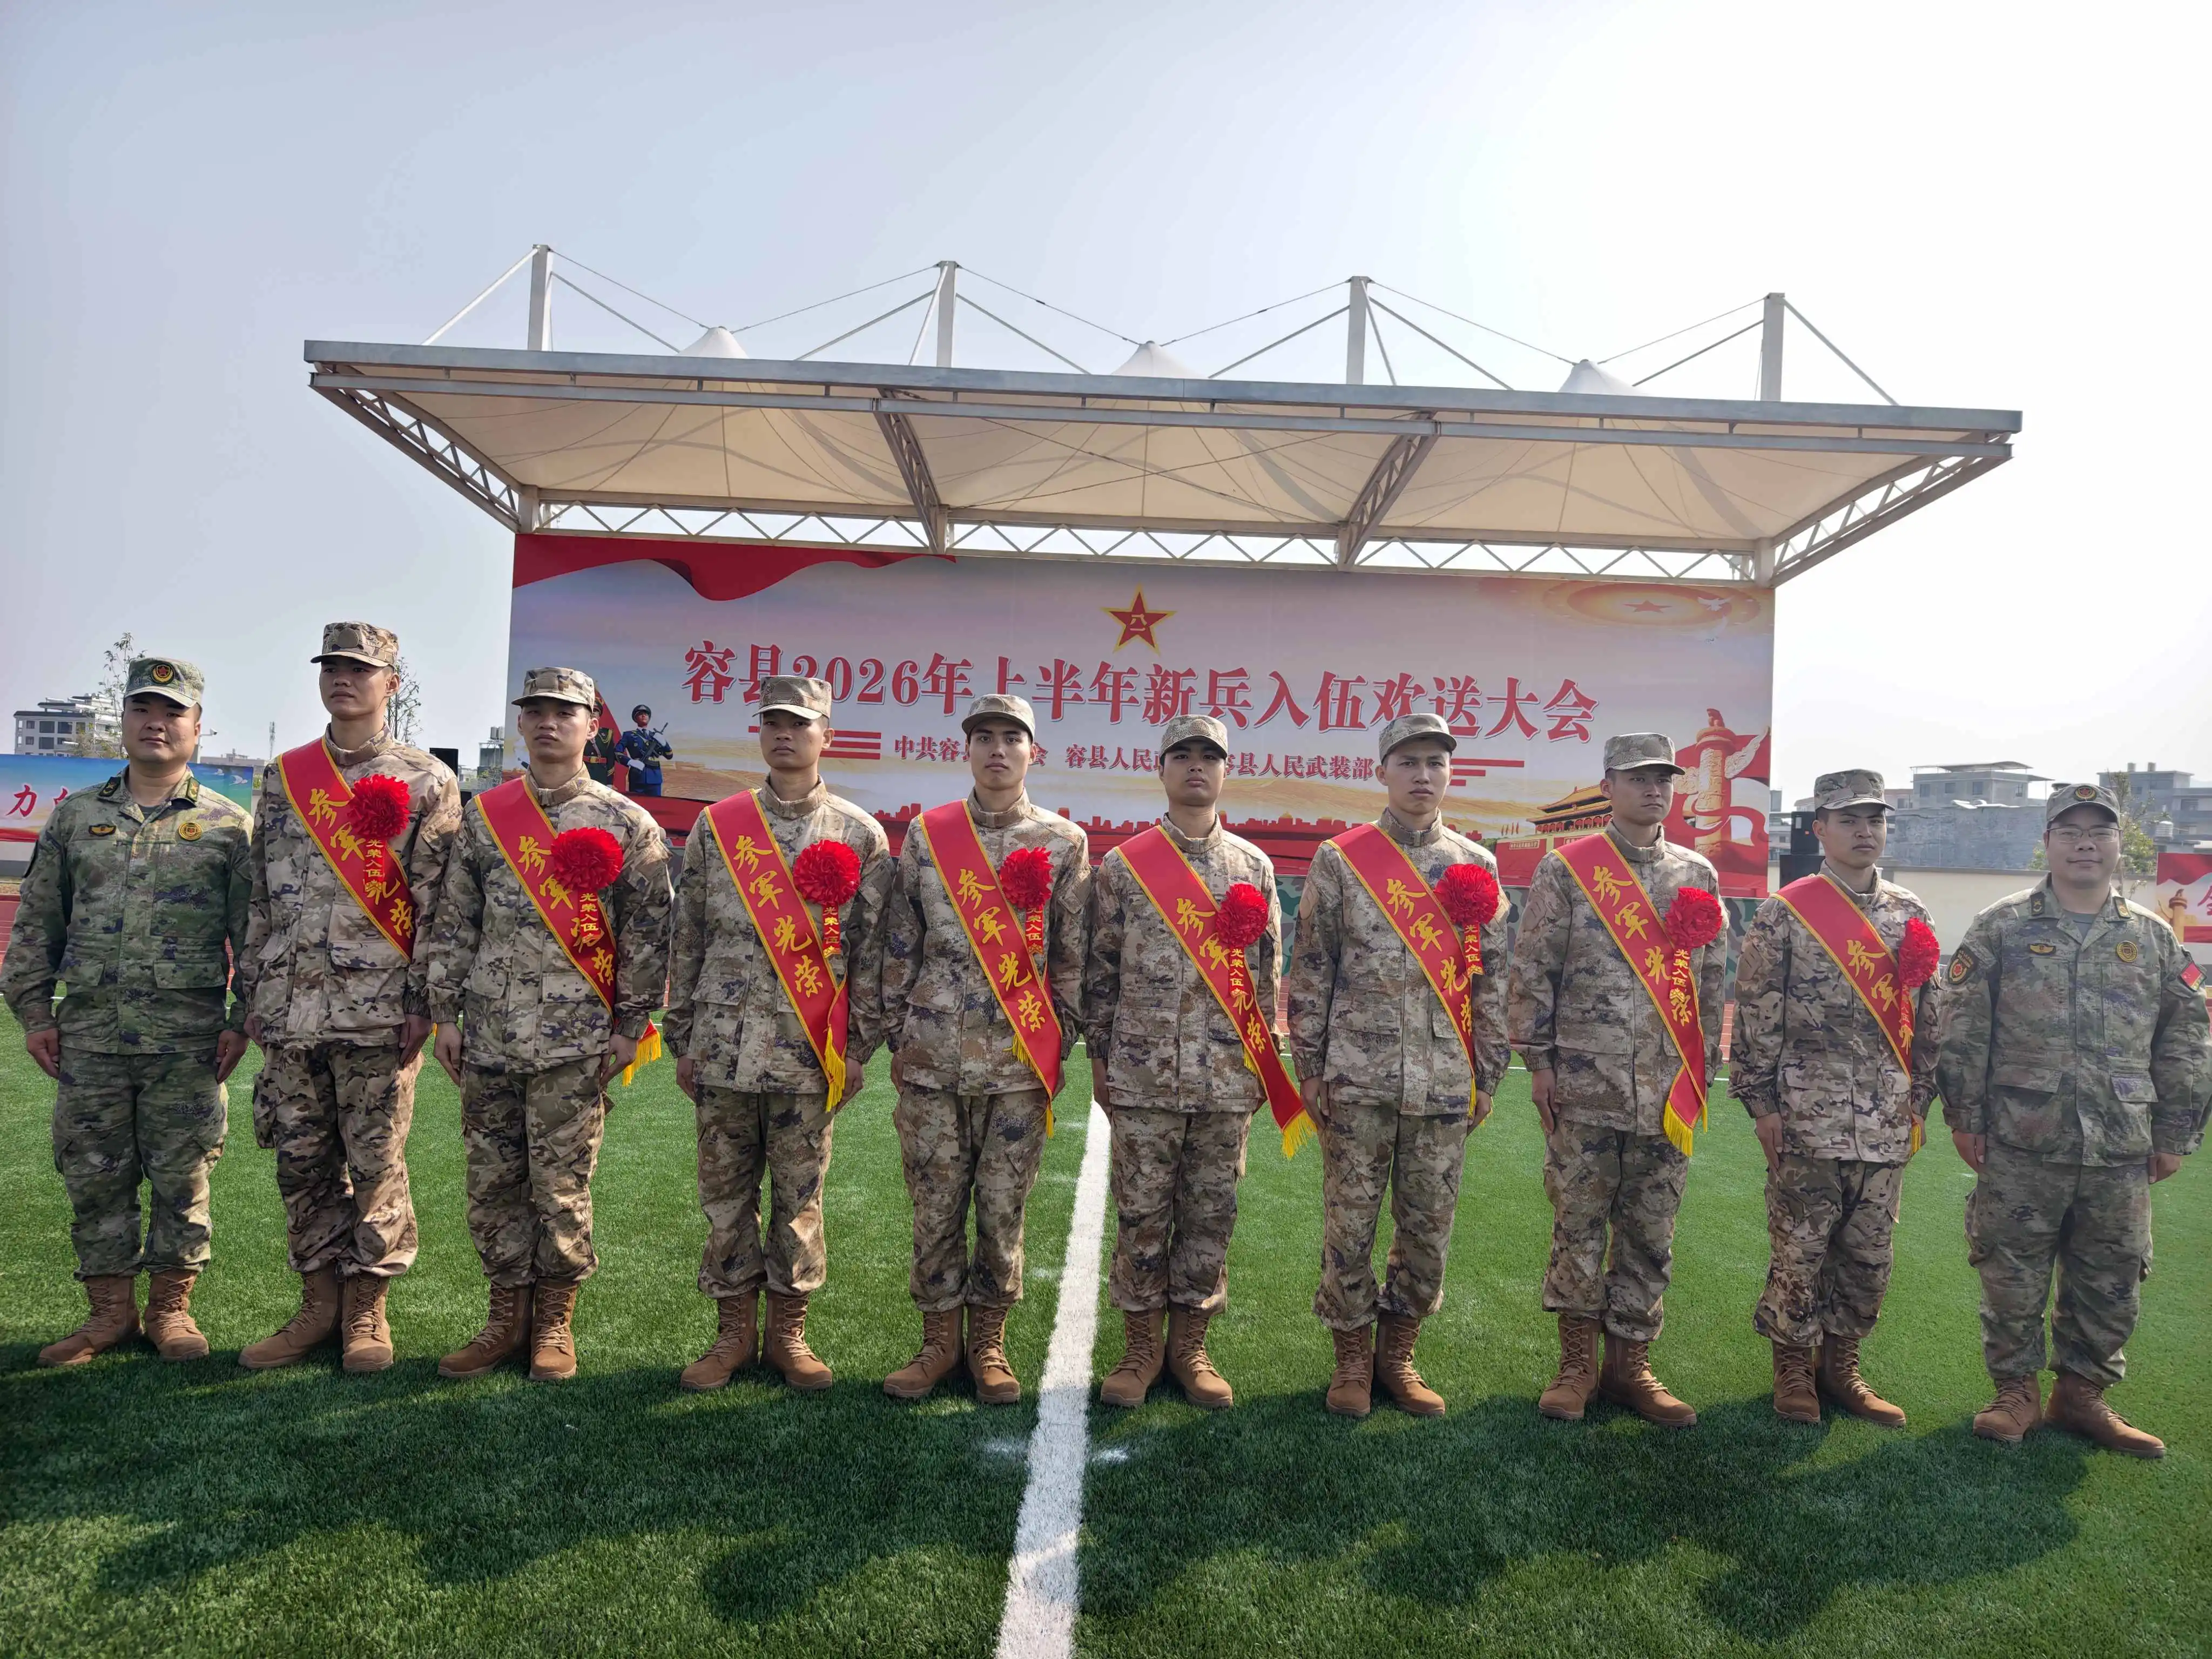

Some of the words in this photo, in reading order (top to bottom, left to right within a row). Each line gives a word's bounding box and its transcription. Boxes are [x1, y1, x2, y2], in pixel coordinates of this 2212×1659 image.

[1065, 743, 1161, 772] 容县人民
[366, 839, 384, 878] 光荣入伍
[579, 893, 598, 932] 光荣入伍
[822, 907, 840, 945] 光荣入伍
[1026, 907, 1043, 941] 光荣入伍
[1464, 924, 1480, 962] 光荣入伍
[1230, 949, 1244, 987] 光荣入伍
[1672, 949, 1690, 988] 光荣入伍
